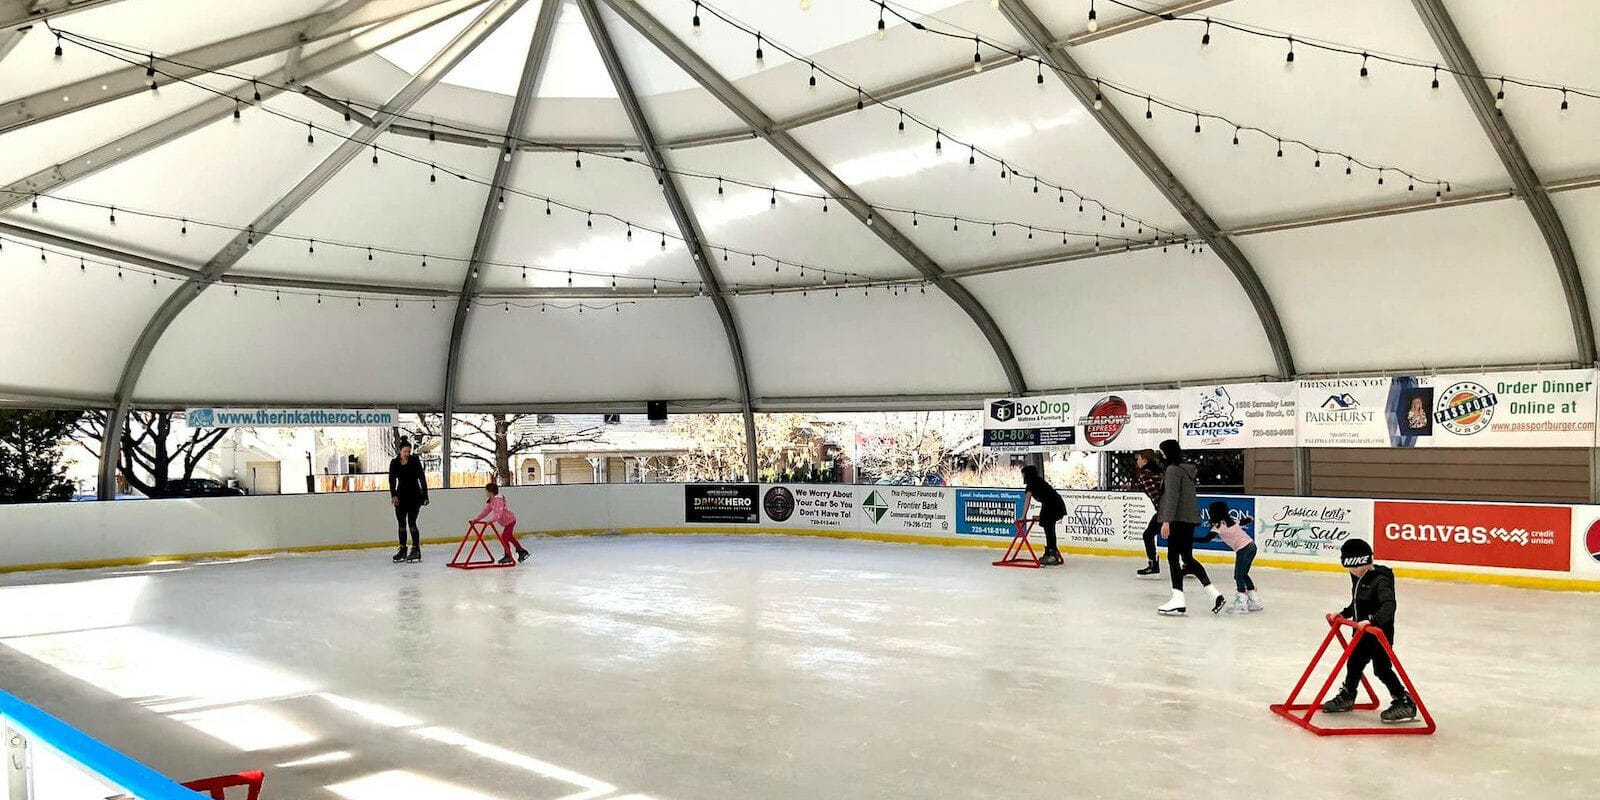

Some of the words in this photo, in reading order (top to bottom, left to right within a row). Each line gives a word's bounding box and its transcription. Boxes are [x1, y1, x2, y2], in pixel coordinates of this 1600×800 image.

[1299, 380, 1358, 388] BRINGING
[1497, 382, 1538, 394] Order
[1542, 380, 1592, 393] Dinner
[1016, 400, 1070, 422] BoxDrop
[1436, 395, 1495, 423] PASSPORT
[1510, 401, 1555, 414] Online
[1561, 401, 1577, 413] at
[217, 410, 391, 424] www.therinkattherock.com
[1305, 411, 1375, 422] PARKHURST
[1446, 409, 1492, 433] BURGER
[1087, 424, 1118, 433] EXPRESS
[1182, 420, 1244, 429] MEADOWS
[1490, 421, 1595, 431] www.passportburger.com
[990, 429, 1035, 441] 30-80%
[1186, 428, 1239, 437] EXPRESS
[795, 488, 808, 496] We
[809, 489, 831, 499] Worry
[832, 490, 853, 498] About
[900, 490, 916, 498] Project
[917, 490, 938, 498] Financed
[938, 491, 945, 499] By
[694, 497, 752, 506] DRINKHERO
[814, 499, 828, 507] Car
[829, 500, 839, 508] So
[897, 500, 921, 509] Frontier
[922, 501, 938, 509] Bank
[799, 509, 819, 517] Don't
[978, 507, 997, 516] Picket
[997, 508, 1014, 518] Realty
[1273, 505, 1318, 521] Jessica
[1067, 516, 1113, 526] DIAMOND
[1065, 525, 1115, 536] EXTERIORS
[1273, 523, 1306, 538] For
[1309, 526, 1350, 541] Sale
[1385, 523, 1488, 545] canvas
[1531, 530, 1554, 538] credit
[1343, 555, 1370, 567] NIKE
